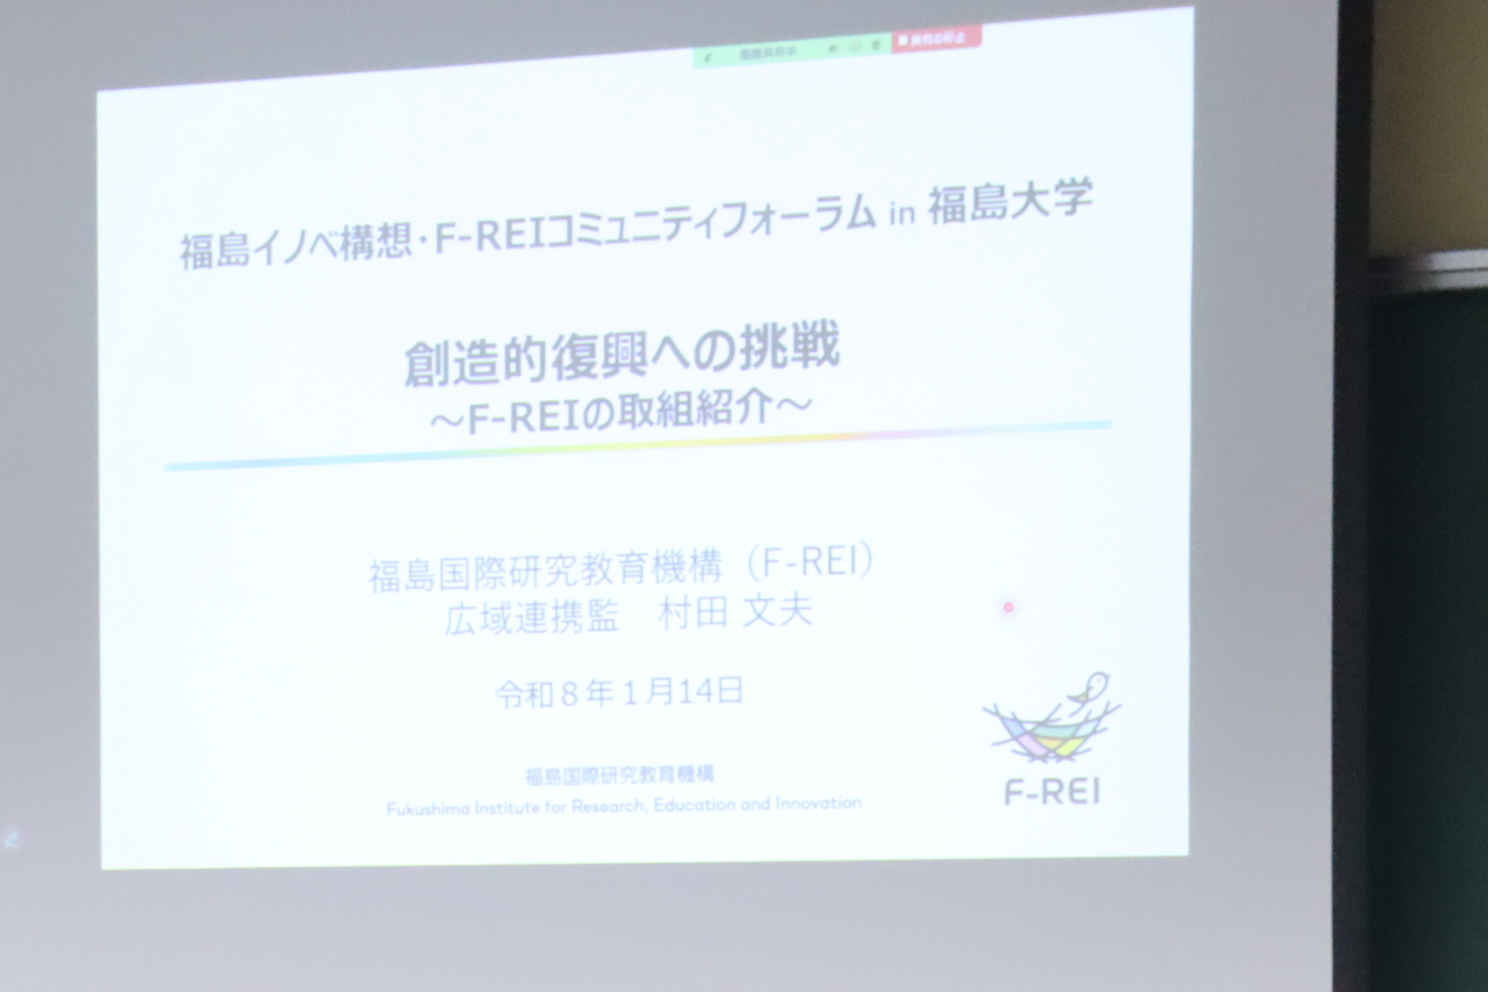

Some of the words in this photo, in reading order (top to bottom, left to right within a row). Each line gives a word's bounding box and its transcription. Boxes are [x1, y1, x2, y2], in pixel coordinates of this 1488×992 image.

[888, 200, 917, 227] in
[926, 174, 1095, 226] 福島大学
[403, 316, 842, 390] 創造的復興への挑戦
[444, 597, 621, 637] 広域連携監
[657, 593, 728, 632] 村田
[742, 589, 814, 628] 文夫
[525, 763, 715, 787] 福島国際研究教育機構
[1003, 775, 1102, 807] F-REI
[385, 800, 470, 817] Fukushima
[474, 799, 541, 816] Institute
[544, 798, 568, 815] for
[571, 797, 649, 815] Research,
[653, 796, 737, 813] Education
[740, 795, 772, 812] and
[775, 795, 863, 811] Innovation
